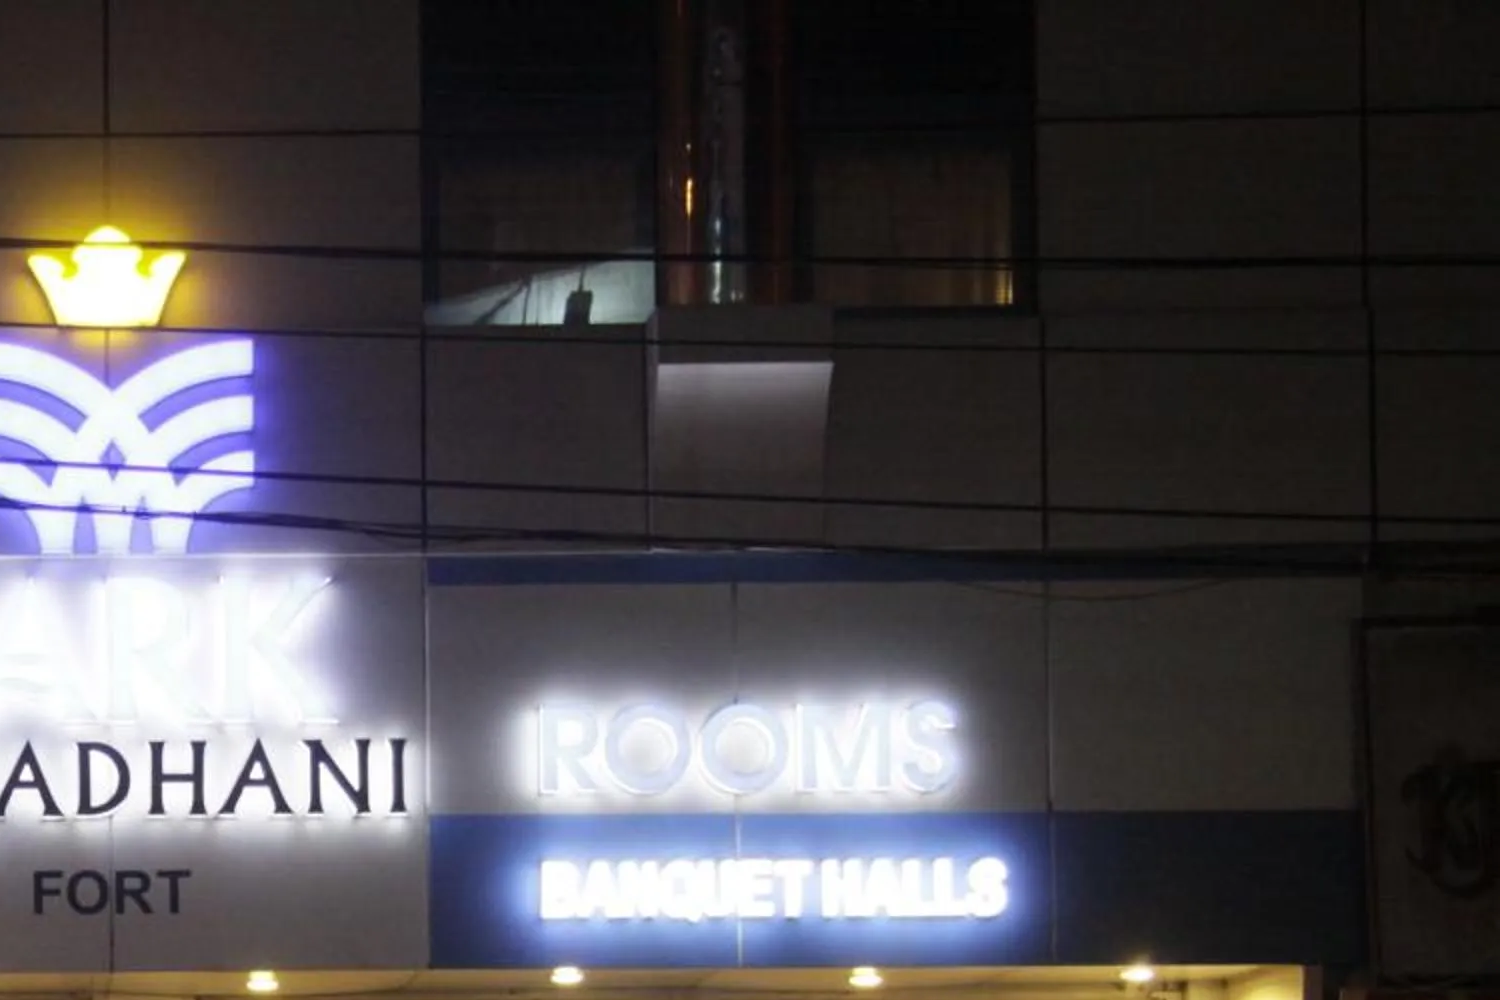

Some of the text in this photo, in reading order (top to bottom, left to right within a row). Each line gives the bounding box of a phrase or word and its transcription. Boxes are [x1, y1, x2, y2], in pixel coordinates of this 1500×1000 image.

[538, 701, 960, 796] ROOMS
[32, 869, 191, 915] FORT
[538, 857, 1010, 924] BANQUET HALLS
